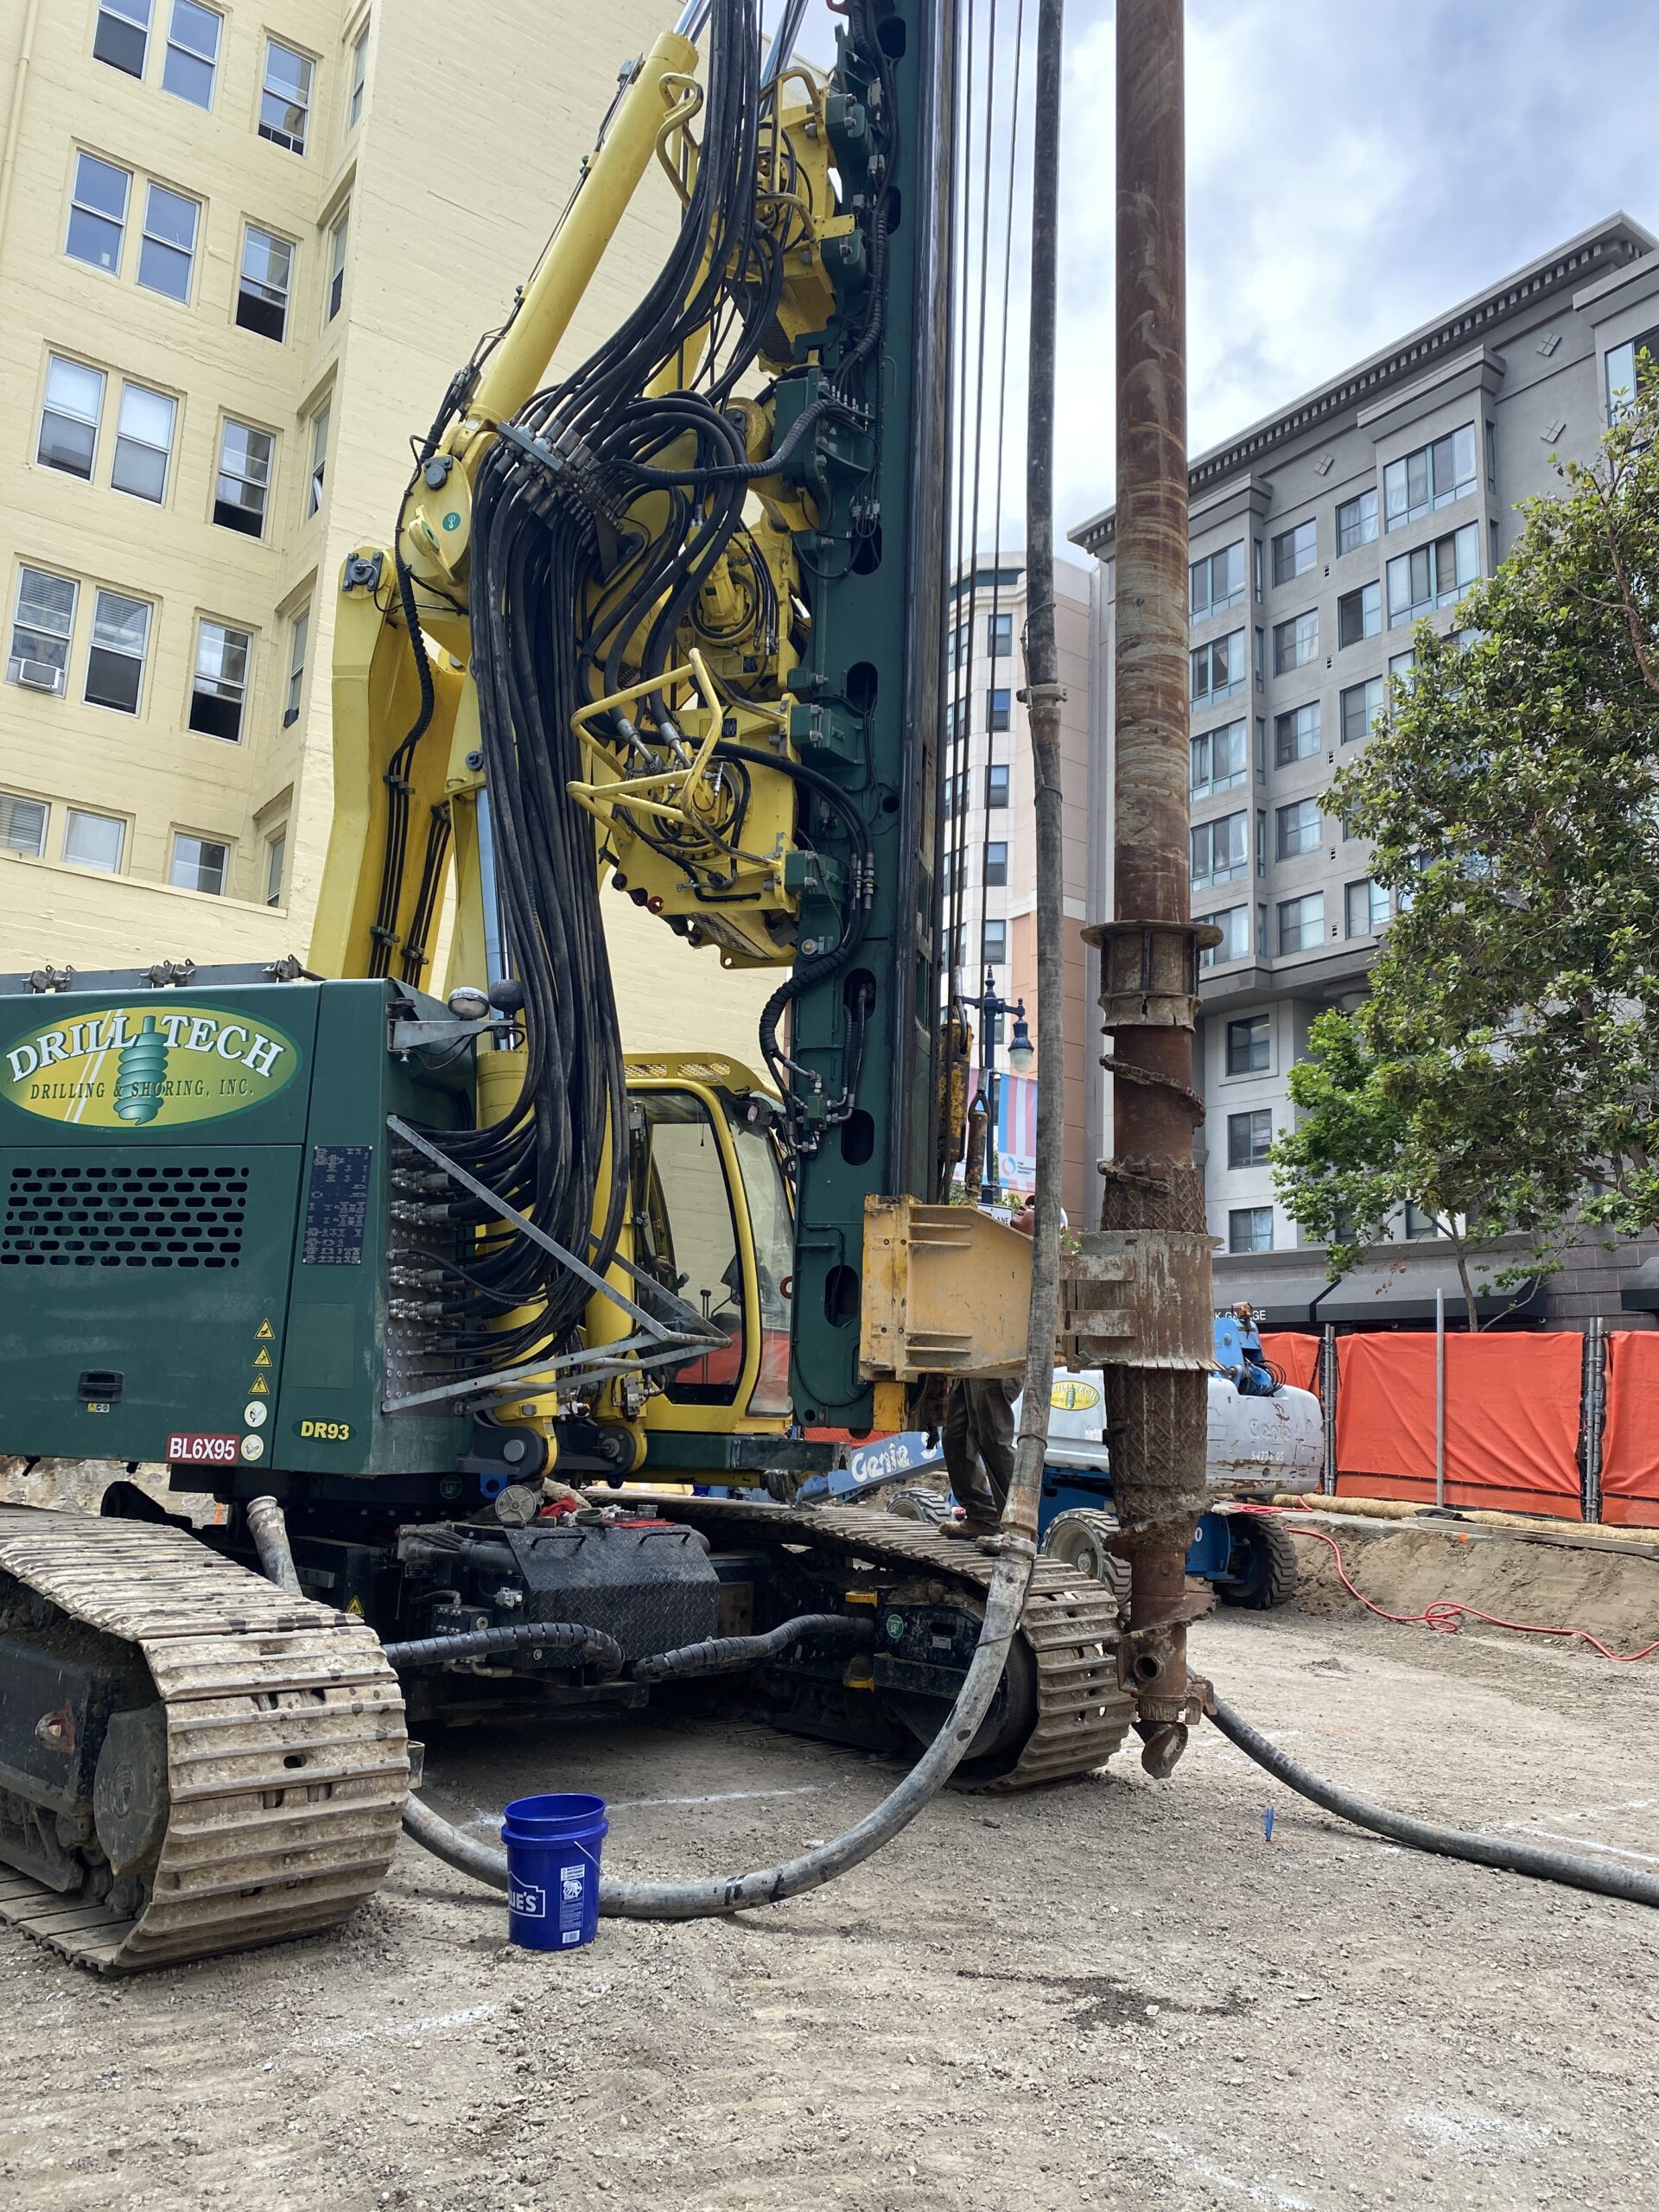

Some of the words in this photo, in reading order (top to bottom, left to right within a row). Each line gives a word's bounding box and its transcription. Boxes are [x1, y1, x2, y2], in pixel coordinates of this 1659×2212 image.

[6, 1016, 138, 1083] DRILL
[161, 1014, 284, 1078] TECH
[30, 1083, 105, 1099] DRILLING
[113, 1083, 123, 1097] &
[131, 1079, 210, 1098] SHORING,
[219, 1078, 254, 1096] INC.
[301, 1421, 349, 1440] DR93
[169, 1437, 235, 1460] BL6X95
[851, 1443, 911, 1483] Genie
